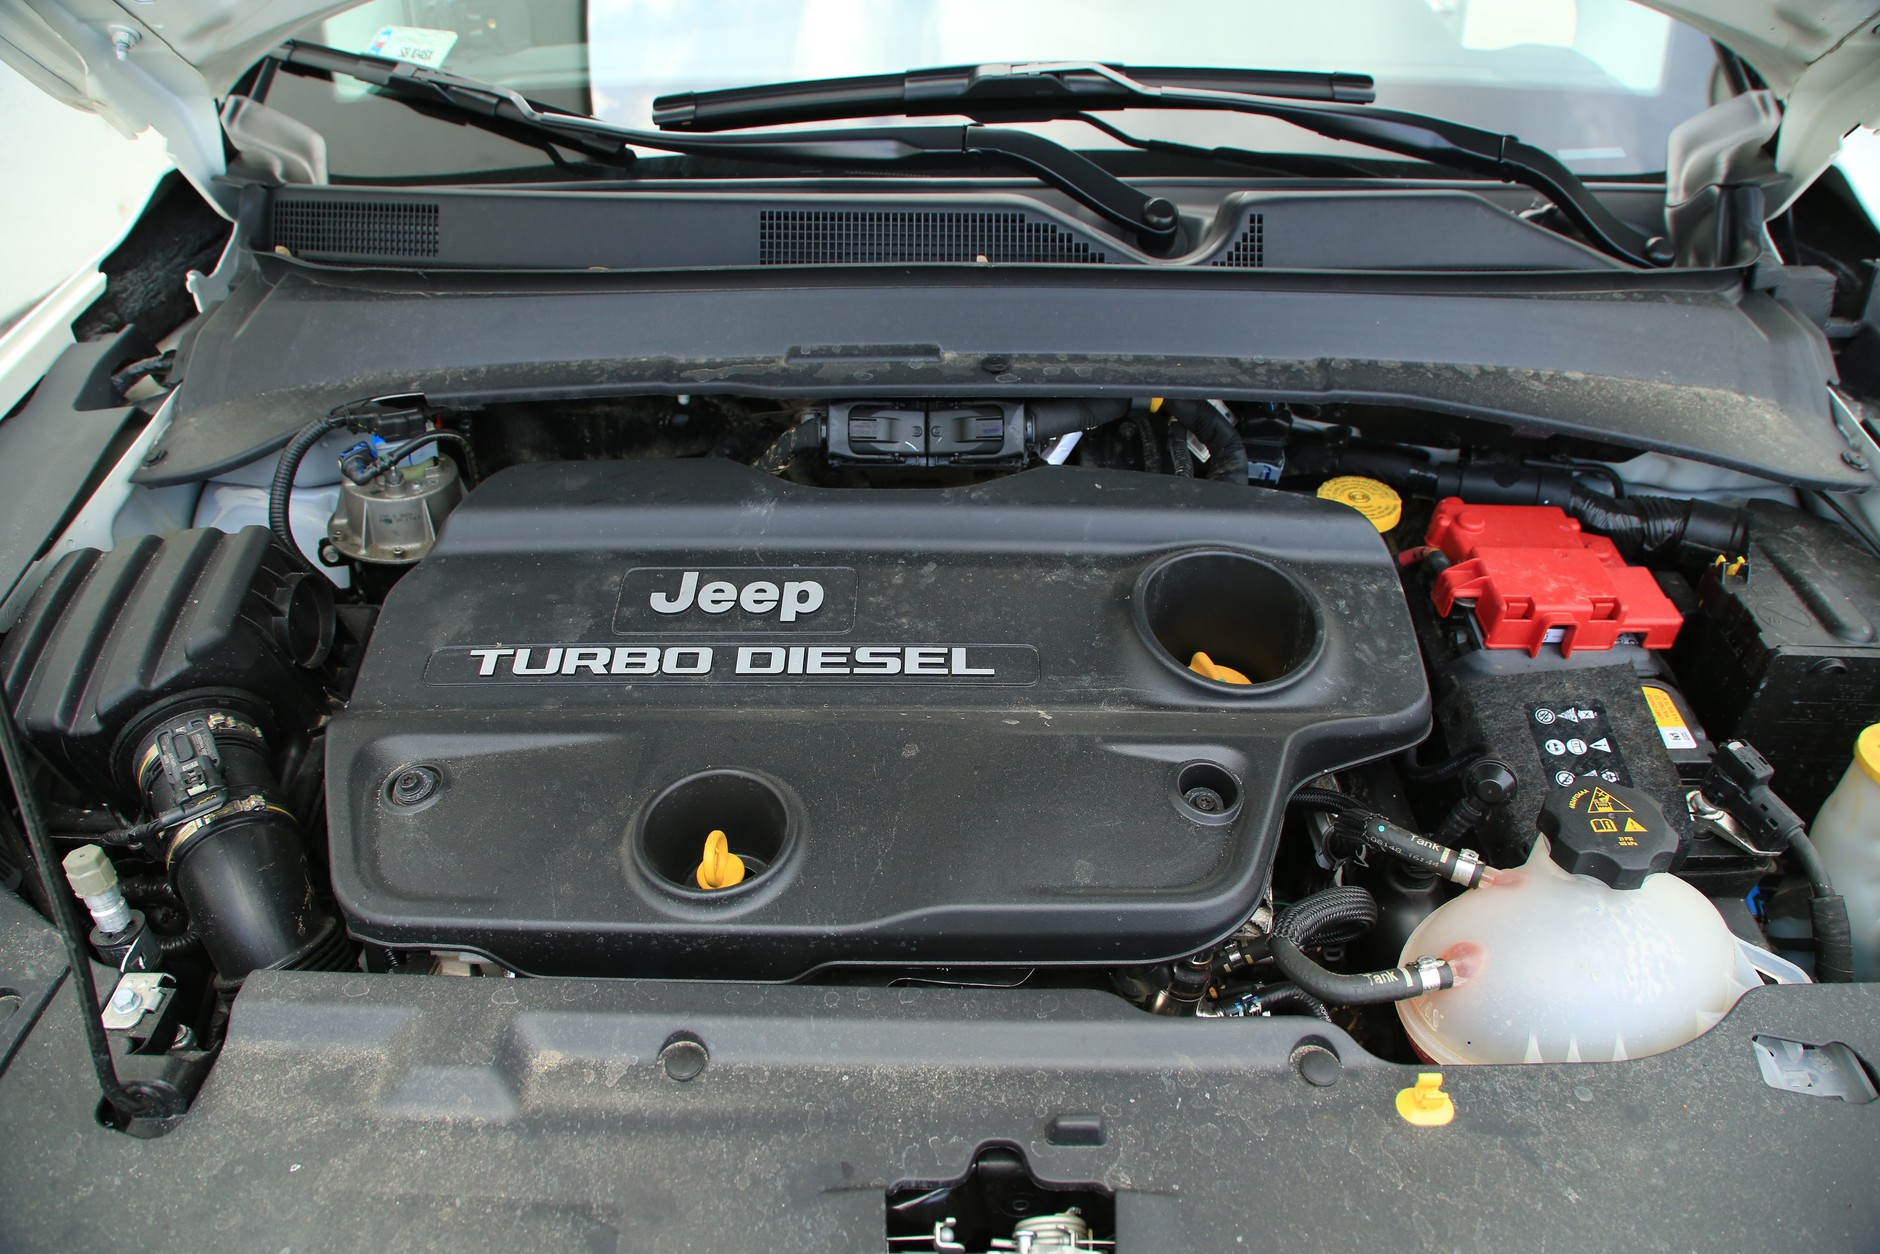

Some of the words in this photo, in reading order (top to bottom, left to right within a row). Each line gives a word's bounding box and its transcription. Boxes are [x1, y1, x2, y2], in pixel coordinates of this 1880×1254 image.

[650, 571, 824, 622] Jeep
[470, 647, 713, 676] TURBO
[735, 646, 995, 675] DIESEL
[1409, 833, 1440, 852] Tank
[1363, 970, 1399, 986] Tank
